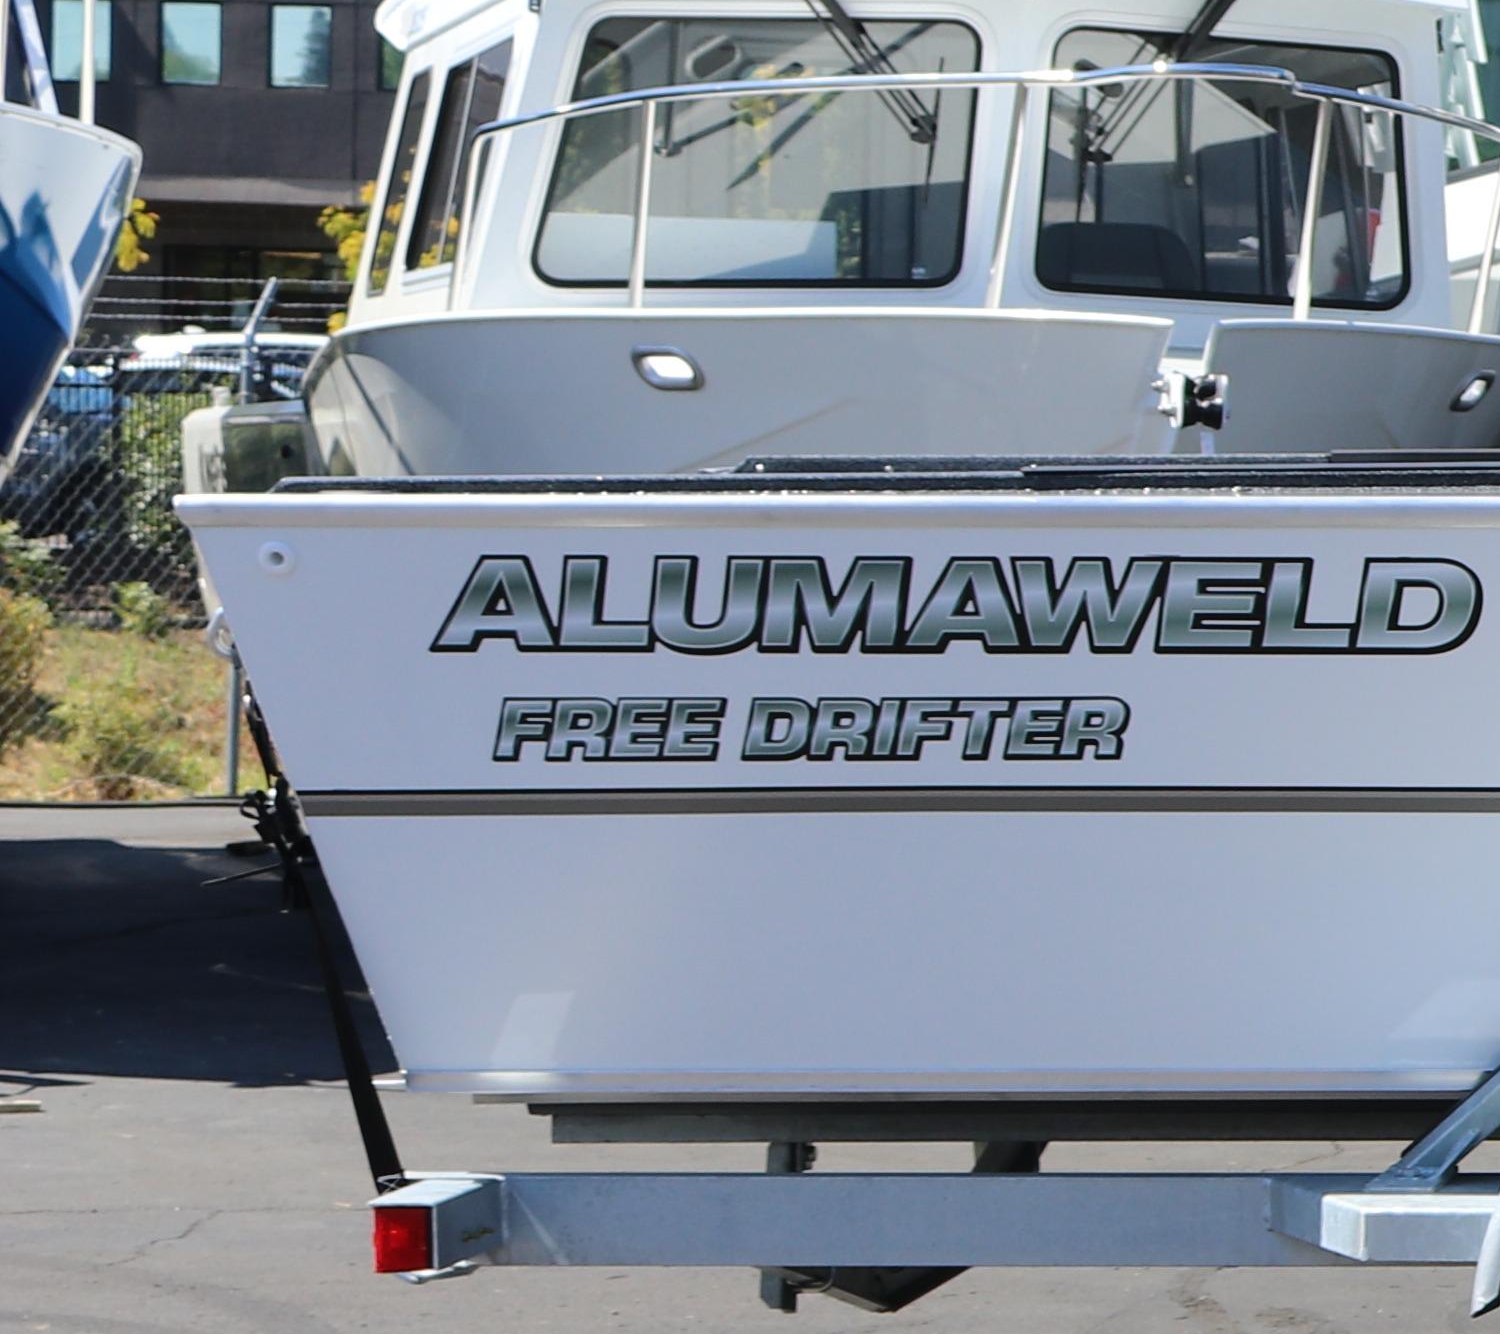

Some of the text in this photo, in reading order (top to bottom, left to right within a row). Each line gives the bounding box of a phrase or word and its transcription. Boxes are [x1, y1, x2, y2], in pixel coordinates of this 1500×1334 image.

[428, 554, 1484, 655] ALUMAWELD
[492, 696, 1131, 762] FREE DRIFTER
